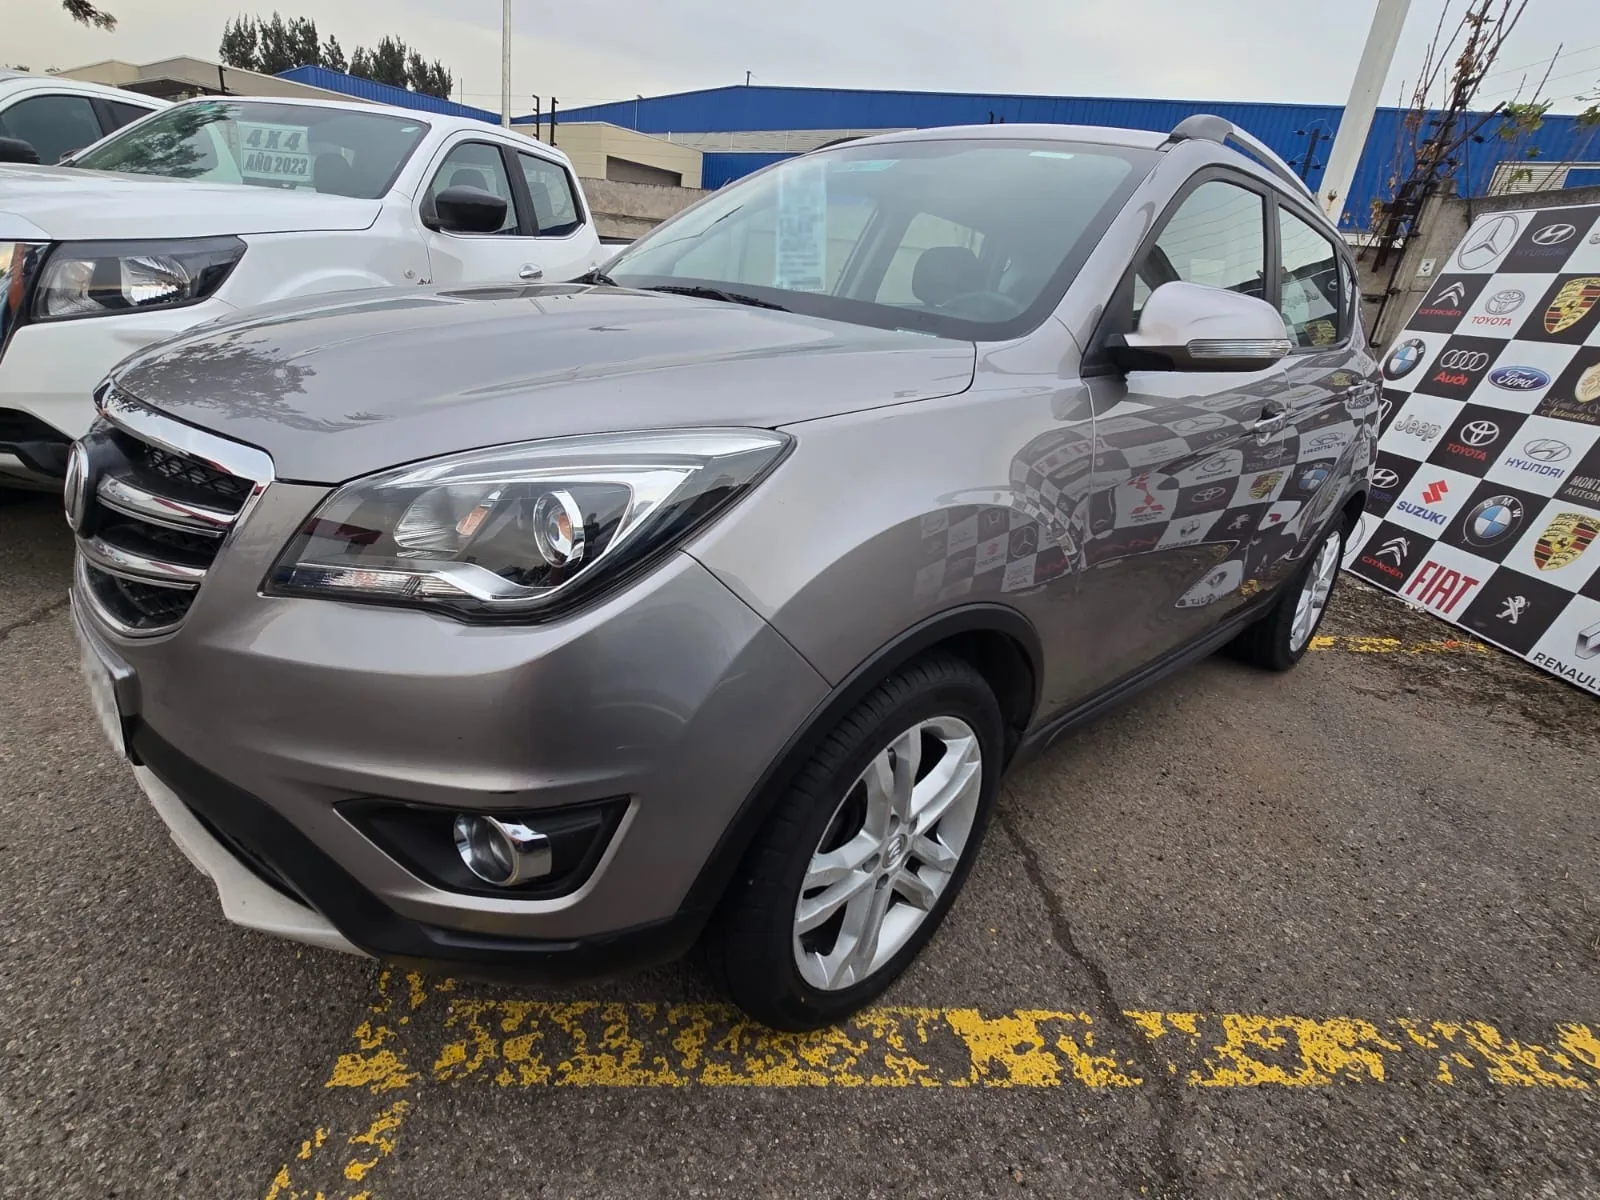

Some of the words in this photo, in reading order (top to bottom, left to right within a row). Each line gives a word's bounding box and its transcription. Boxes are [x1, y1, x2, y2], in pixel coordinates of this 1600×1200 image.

[246, 129, 262, 148] 4
[284, 132, 302, 151] 4
[244, 152, 273, 173] AÑO
[273, 156, 308, 175] 2023
[1472, 316, 1512, 327] TOYOTA
[1433, 371, 1468, 386] Audi
[1497, 369, 1539, 389] Ford
[1394, 414, 1442, 442] Jeep
[1446, 442, 1488, 461] TOYOTA
[1504, 457, 1565, 479] HYUNDAI
[1569, 475, 1600, 493] MONT
[1396, 500, 1447, 525] SUZUKI
[1405, 560, 1480, 614] FIAT
[1533, 651, 1600, 692] RENAUL
